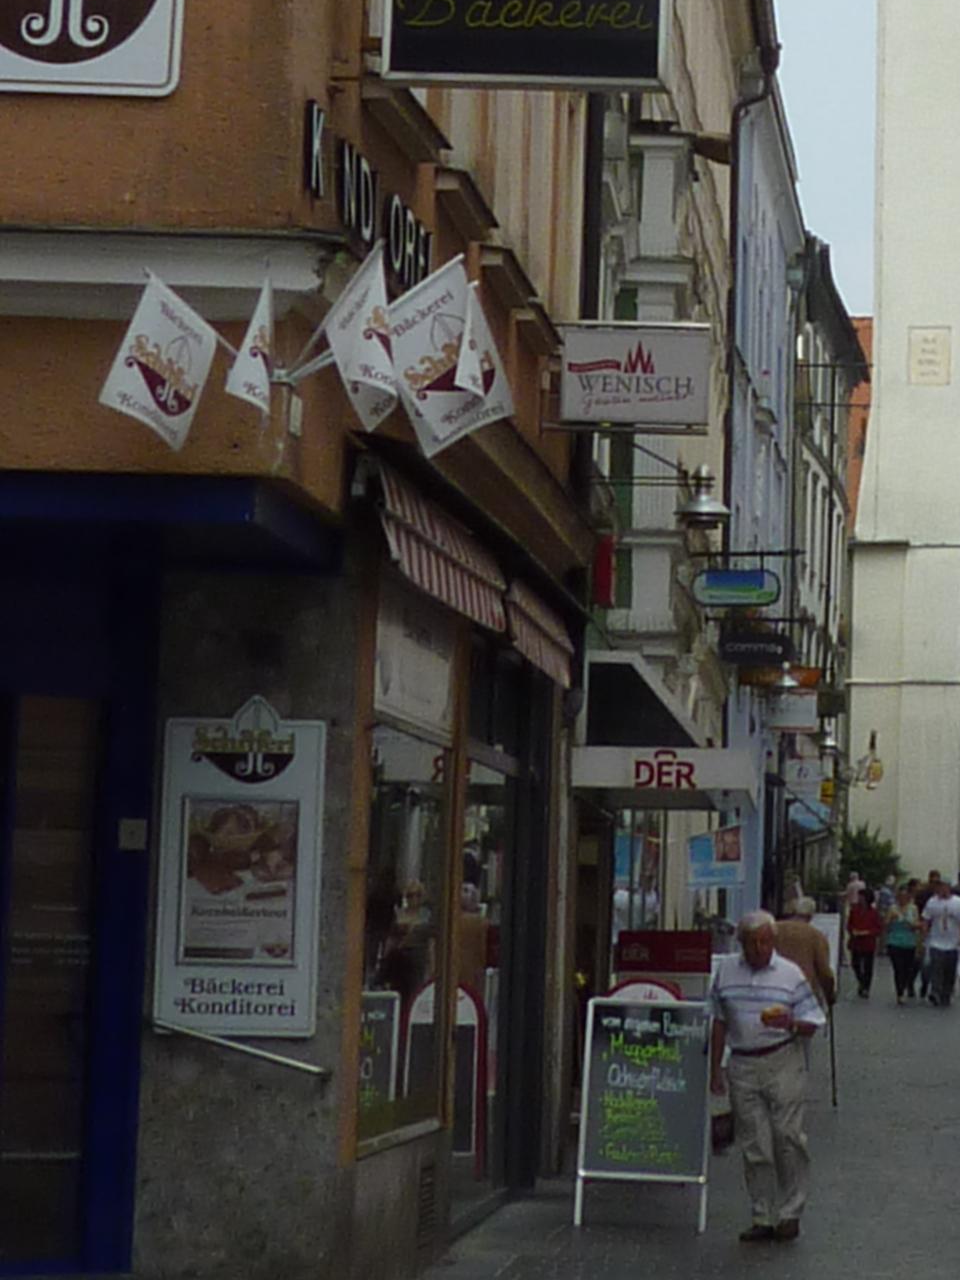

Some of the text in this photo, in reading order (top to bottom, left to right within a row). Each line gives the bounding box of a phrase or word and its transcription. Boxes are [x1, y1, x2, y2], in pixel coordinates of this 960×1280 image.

[577, 374, 696, 396] WENISCH
[634, 760, 696, 789] DER
[184, 978, 285, 997] Bäckerei
[174, 998, 296, 1017] Konditorei
